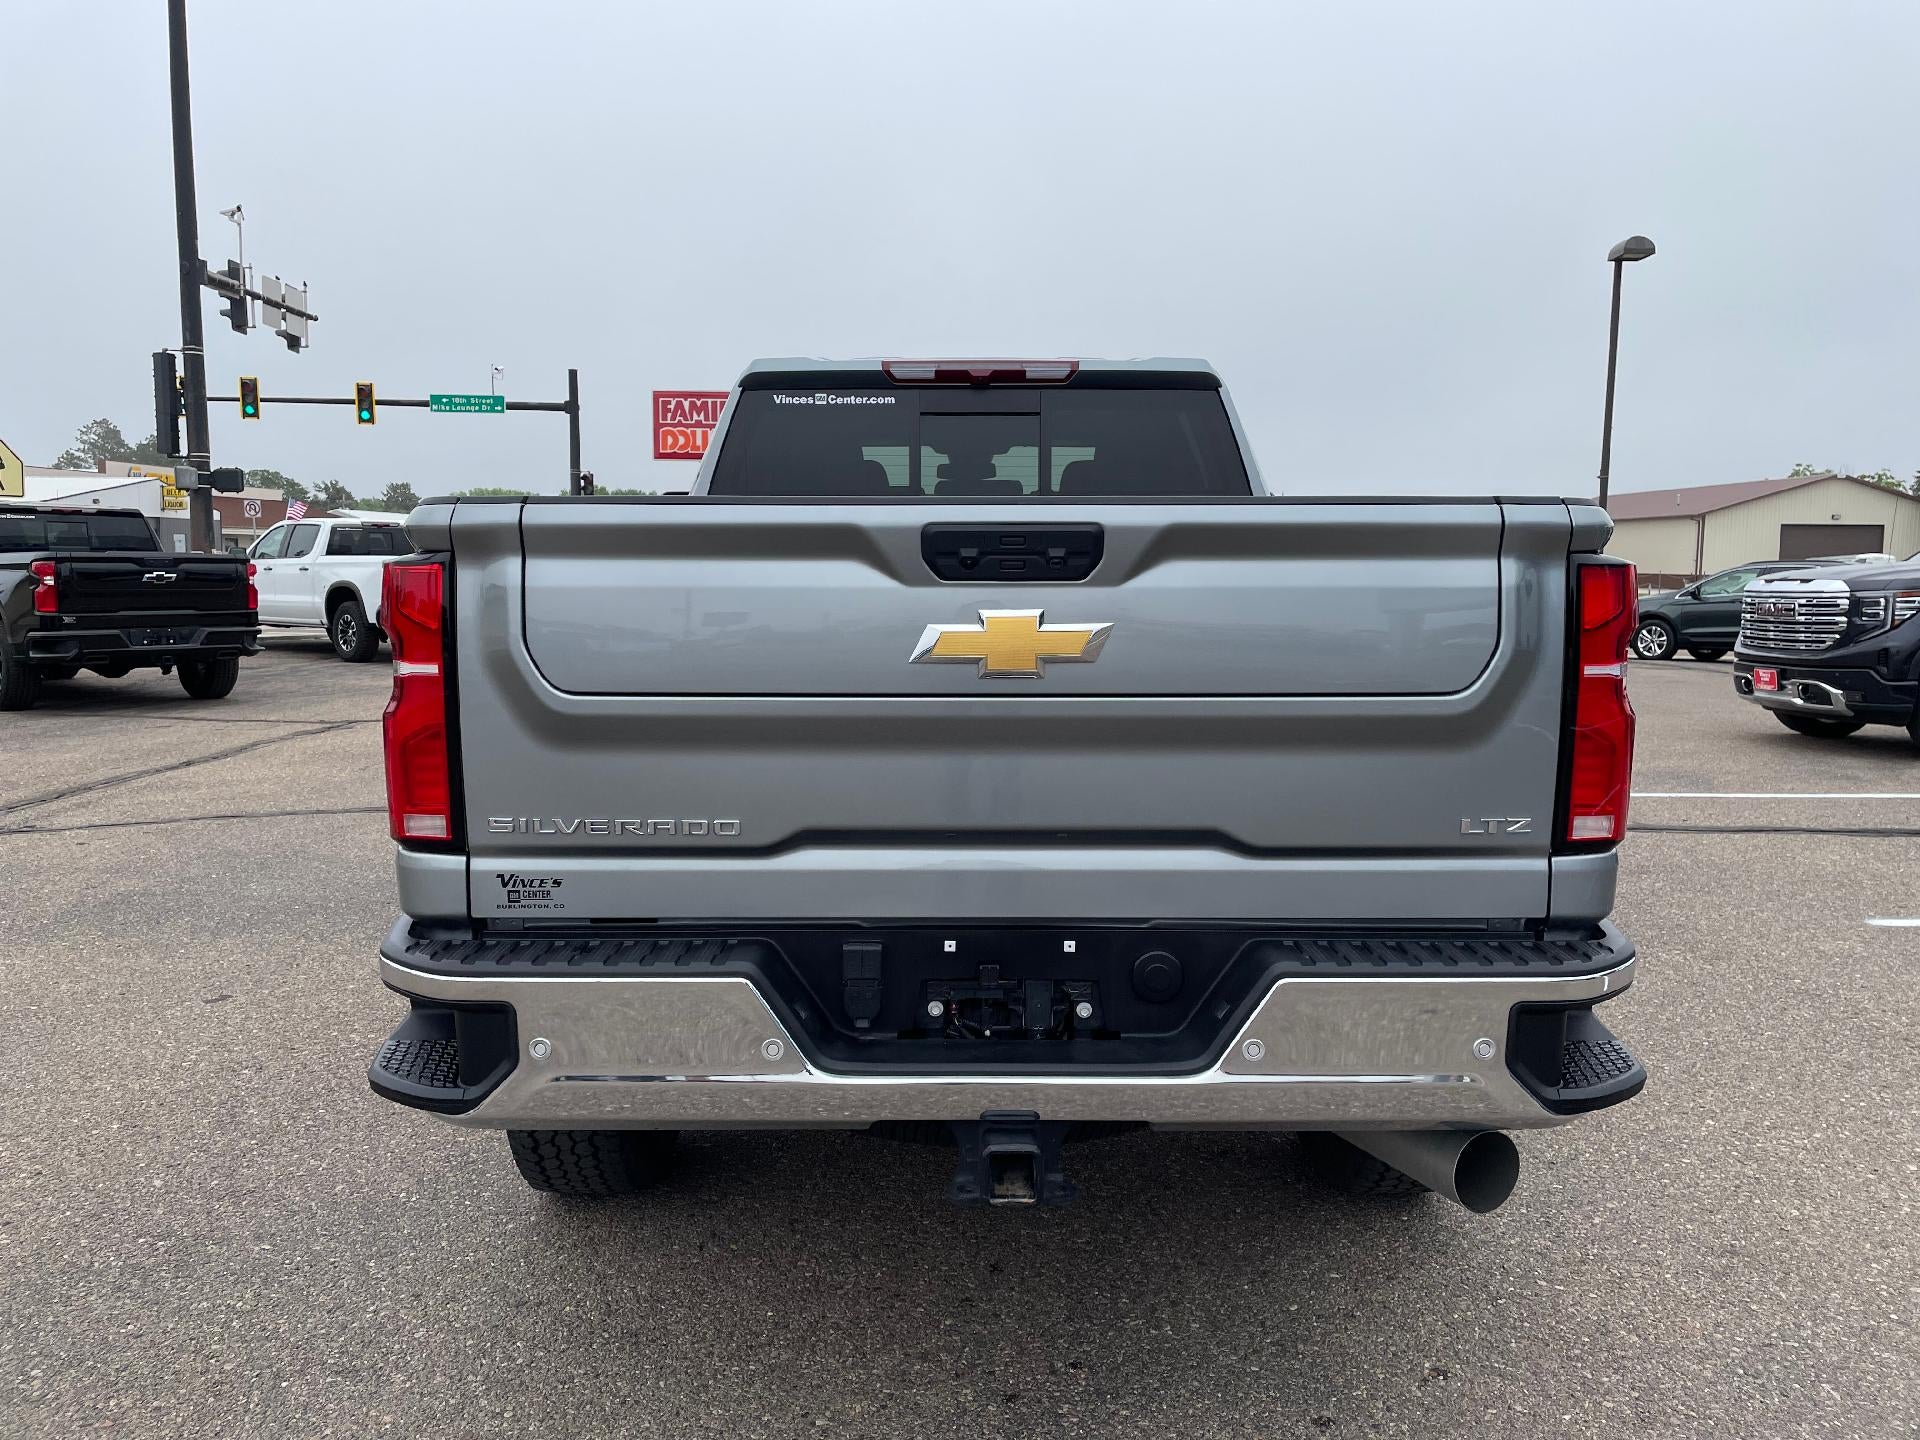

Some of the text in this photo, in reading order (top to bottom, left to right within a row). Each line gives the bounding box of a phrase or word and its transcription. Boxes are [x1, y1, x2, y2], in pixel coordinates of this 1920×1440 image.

[432, 404, 450, 412] Mike
[451, 404, 480, 412] Lounge
[659, 398, 728, 424] FAMI
[659, 427, 716, 453] DOLL
[1758, 603, 1794, 616] GMC
[487, 817, 742, 836] SILVERADO
[1460, 818, 1532, 834] LTZ
[522, 890, 551, 898] CENTER
